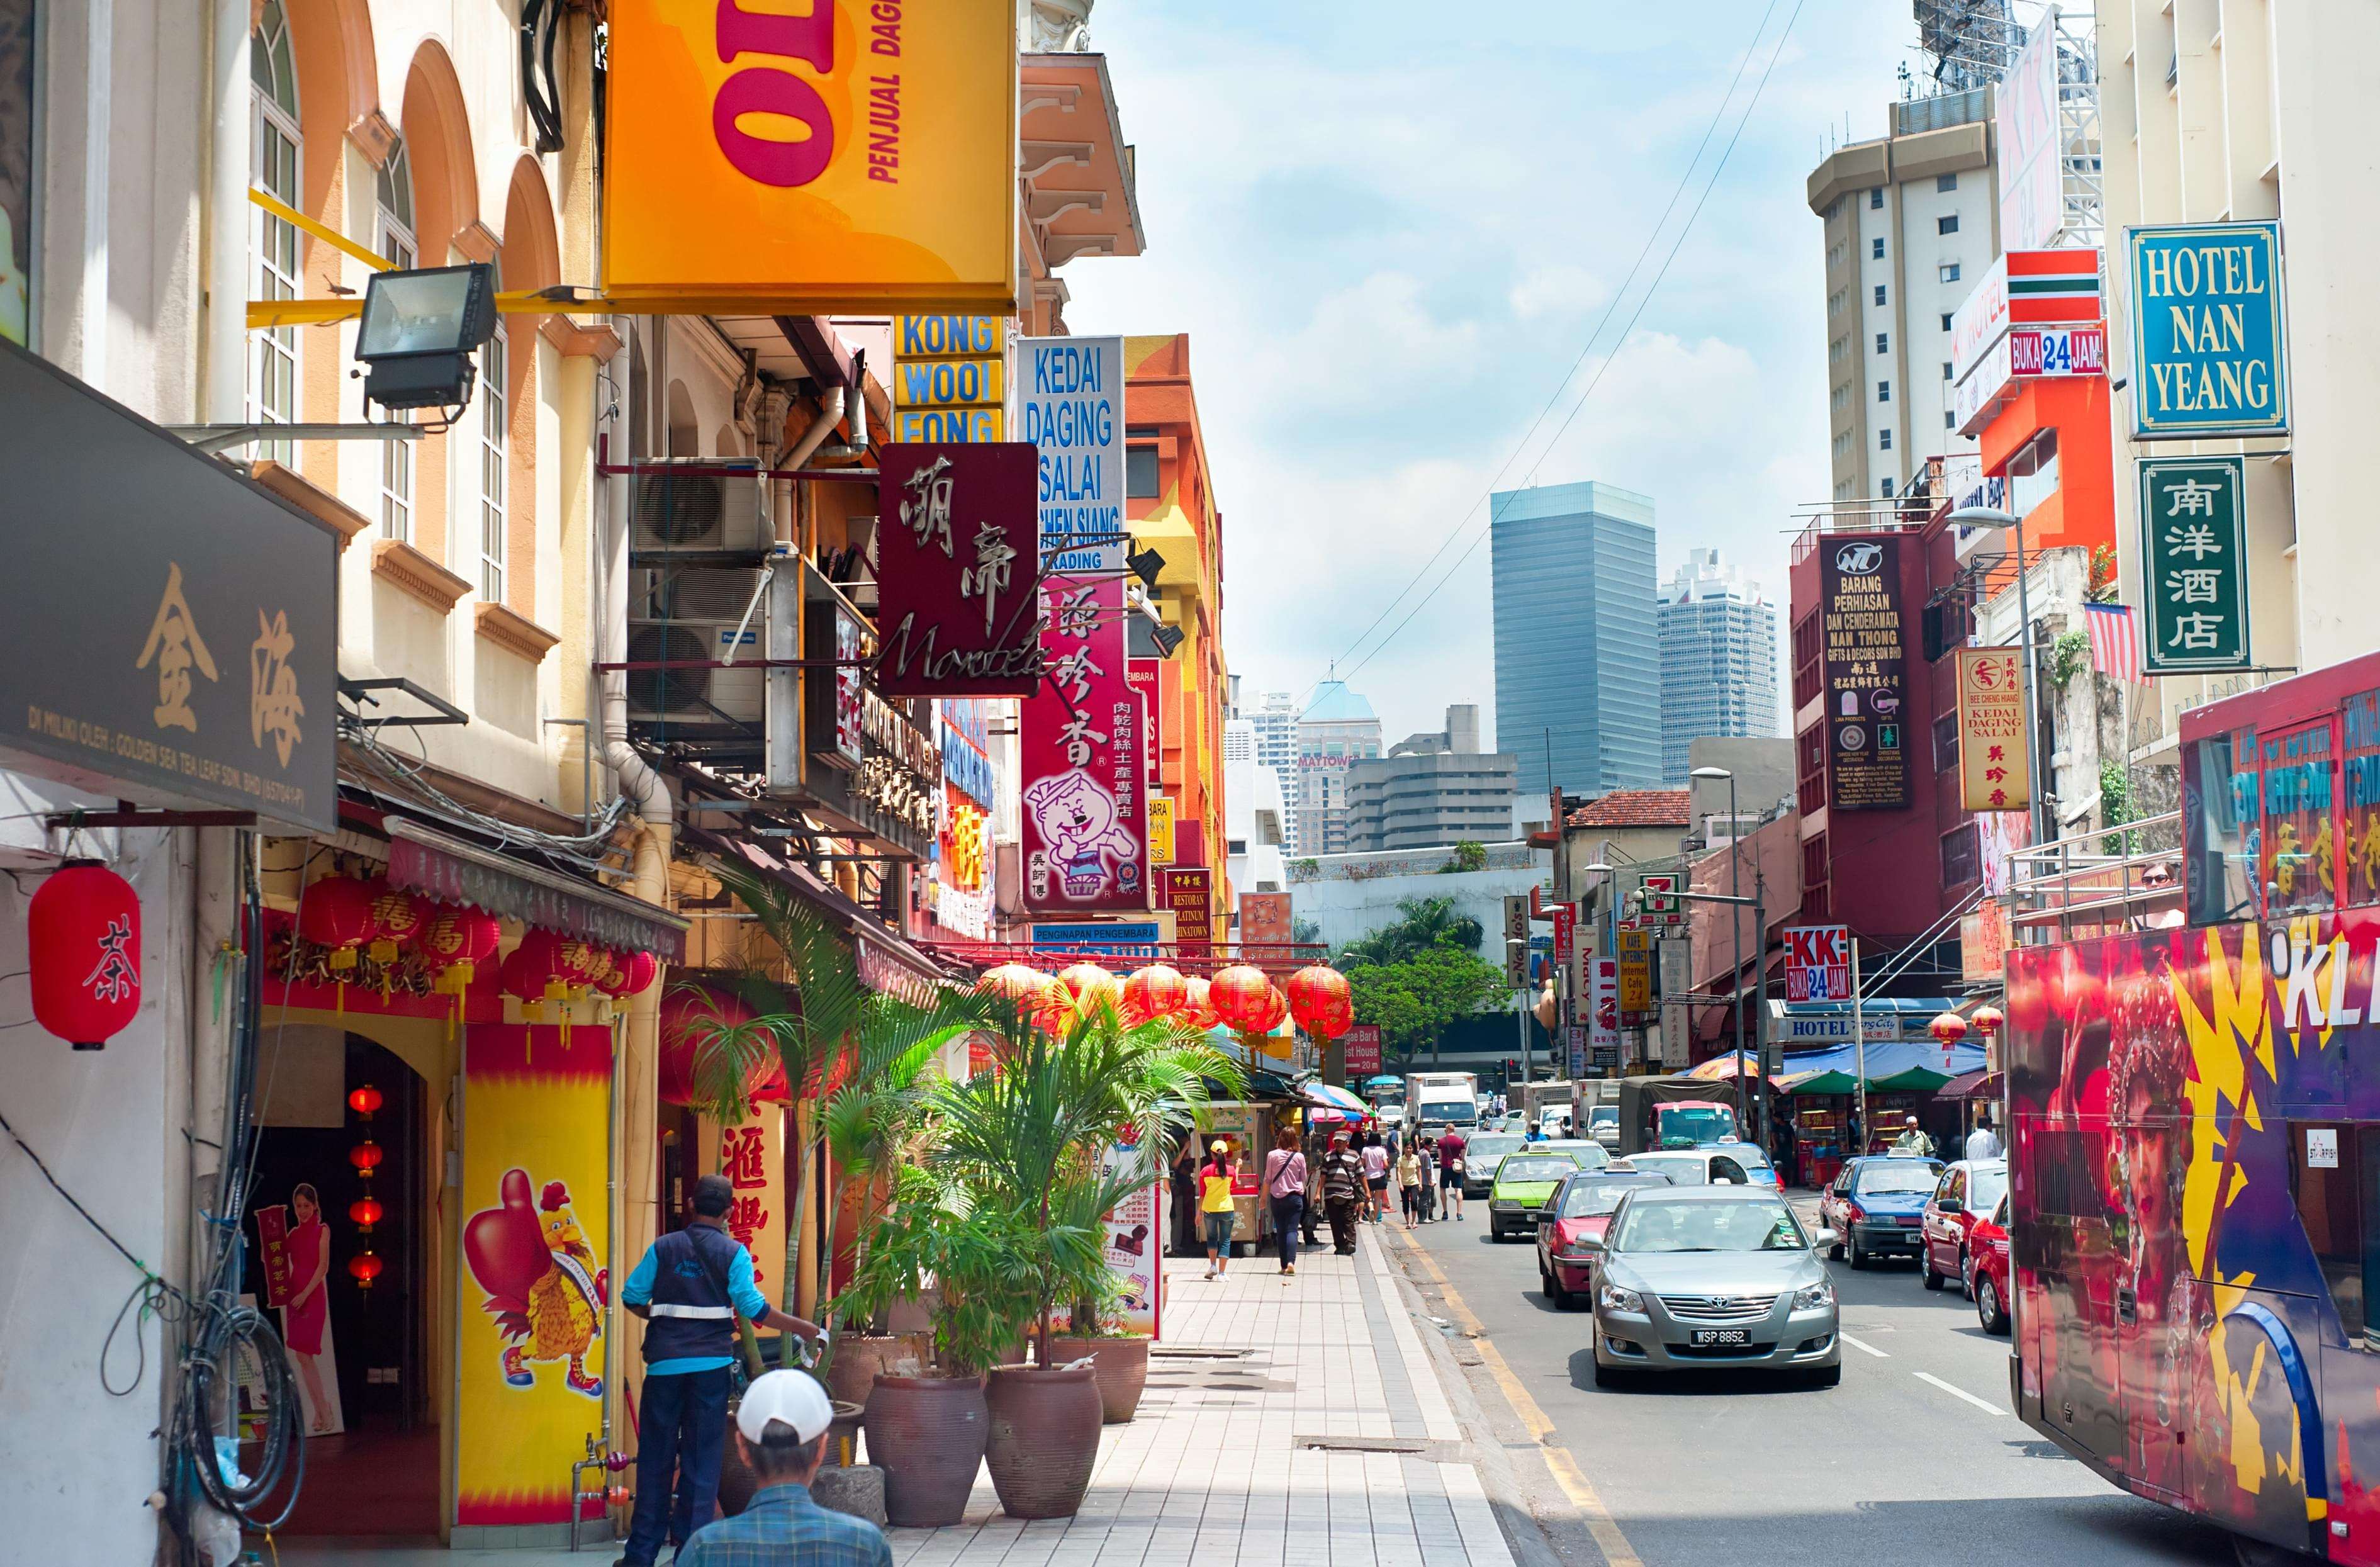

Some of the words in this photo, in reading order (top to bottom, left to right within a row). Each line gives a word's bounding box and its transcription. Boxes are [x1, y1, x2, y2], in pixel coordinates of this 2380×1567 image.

[868, 74, 900, 184] PENJUAL
[2146, 245, 2264, 297] HOTEL
[904, 316, 992, 354] KONG
[2171, 303, 2244, 354] NAN
[2013, 337, 2041, 370] BUKA
[2043, 335, 2070, 370] 24
[2073, 335, 2101, 368] JAM
[1035, 347, 1101, 393] KEDAI
[904, 362, 990, 403] WOOI
[2152, 359, 2269, 412] YEANG
[903, 412, 992, 442] FONG
[1027, 399, 1111, 447] DAGING
[1040, 454, 1101, 502] SALAI
[1078, 506, 1119, 548] SIANG
[1040, 552, 1101, 569] TRADING
[2163, 478, 2225, 649] 南洋酒店
[1841, 575, 1882, 593] BARANG
[1834, 594, 1890, 612] PERHIASAN
[1827, 614, 1843, 630] DAN
[1844, 612, 1899, 629] CENDERAMATA
[1830, 631, 1853, 646] NAN
[1858, 630, 1897, 646] THONG
[1828, 648, 1845, 661] GIFTS
[1846, 648, 1851, 661] &
[1851, 647, 1875, 661] DECORS
[1876, 647, 1888, 660] SDN
[1890, 646, 1901, 659] BHD
[1127, 672, 1154, 682] EMBARA
[1851, 661, 1880, 675] 南通
[2006, 657, 2016, 690] 美珍香
[1970, 695, 1980, 704] BEE
[1982, 694, 1999, 704] CHENG
[2001, 694, 2018, 703] HIANG
[1968, 718, 2021, 728] DAGING
[1971, 708, 2017, 718] KEDAI
[1973, 727, 2017, 738] SALAI
[116, 733, 157, 765] GOLDEN
[159, 745, 177, 772] SEA
[179, 753, 196, 775] TEA
[199, 757, 220, 782] LEAF
[1113, 702, 1133, 817] 肉乾肉絲土產專賣店
[1985, 745, 2009, 807] 美珍香
[1032, 854, 1046, 897] 吳師傅
[1174, 895, 1204, 906] RESTORAN
[1036, 929, 1091, 940] PENGINAPAN
[1094, 928, 1155, 939] PENGEMBARA
[1176, 926, 1208, 936] HINATOWN
[1247, 935, 1288, 943] Family
[1513, 913, 1523, 973] Nado's
[82, 913, 140, 1004] 茶
[1621, 950, 1647, 963] INTERNET
[1792, 929, 1839, 967] KK
[1622, 966, 1647, 976] Internet
[1789, 968, 1808, 998] BUKA
[1809, 969, 1827, 998] 24
[1828, 969, 1846, 996] JAM
[2284, 938, 2380, 1028] KL
[1628, 979, 1642, 988] Cafe
[1360, 1031, 1371, 1041] Bar
[1372, 1031, 1378, 1041] &
[1792, 1020, 1849, 1036] HOTEL
[1345, 1048, 1354, 1057] est
[1356, 1047, 1378, 1057] House
[1697, 1331, 1717, 1342] WSP
[1719, 1331, 1744, 1342] 8852
